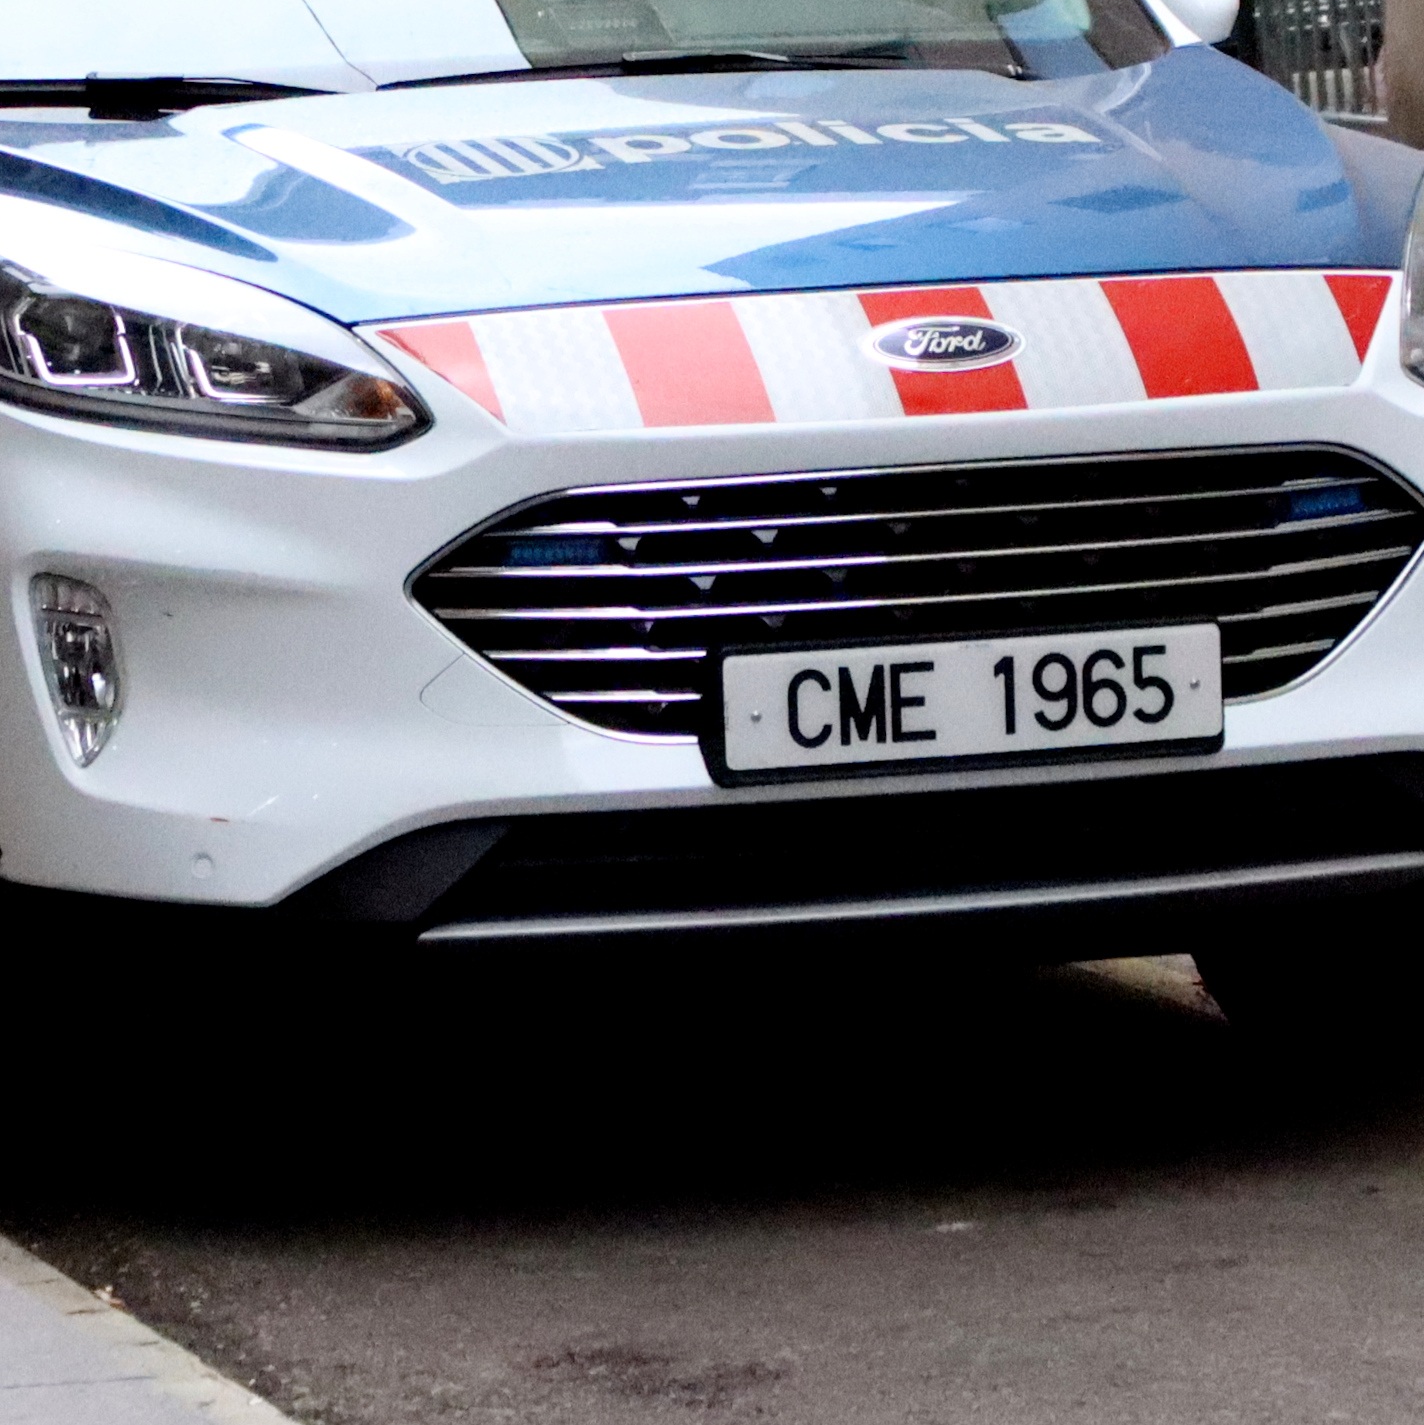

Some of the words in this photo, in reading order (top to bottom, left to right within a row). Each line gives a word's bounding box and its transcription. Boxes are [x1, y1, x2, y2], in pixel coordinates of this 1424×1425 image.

[586, 117, 1102, 163] policia
[903, 325, 986, 356] Ford
[787, 661, 937, 748] CME
[993, 644, 1175, 735] 1965
